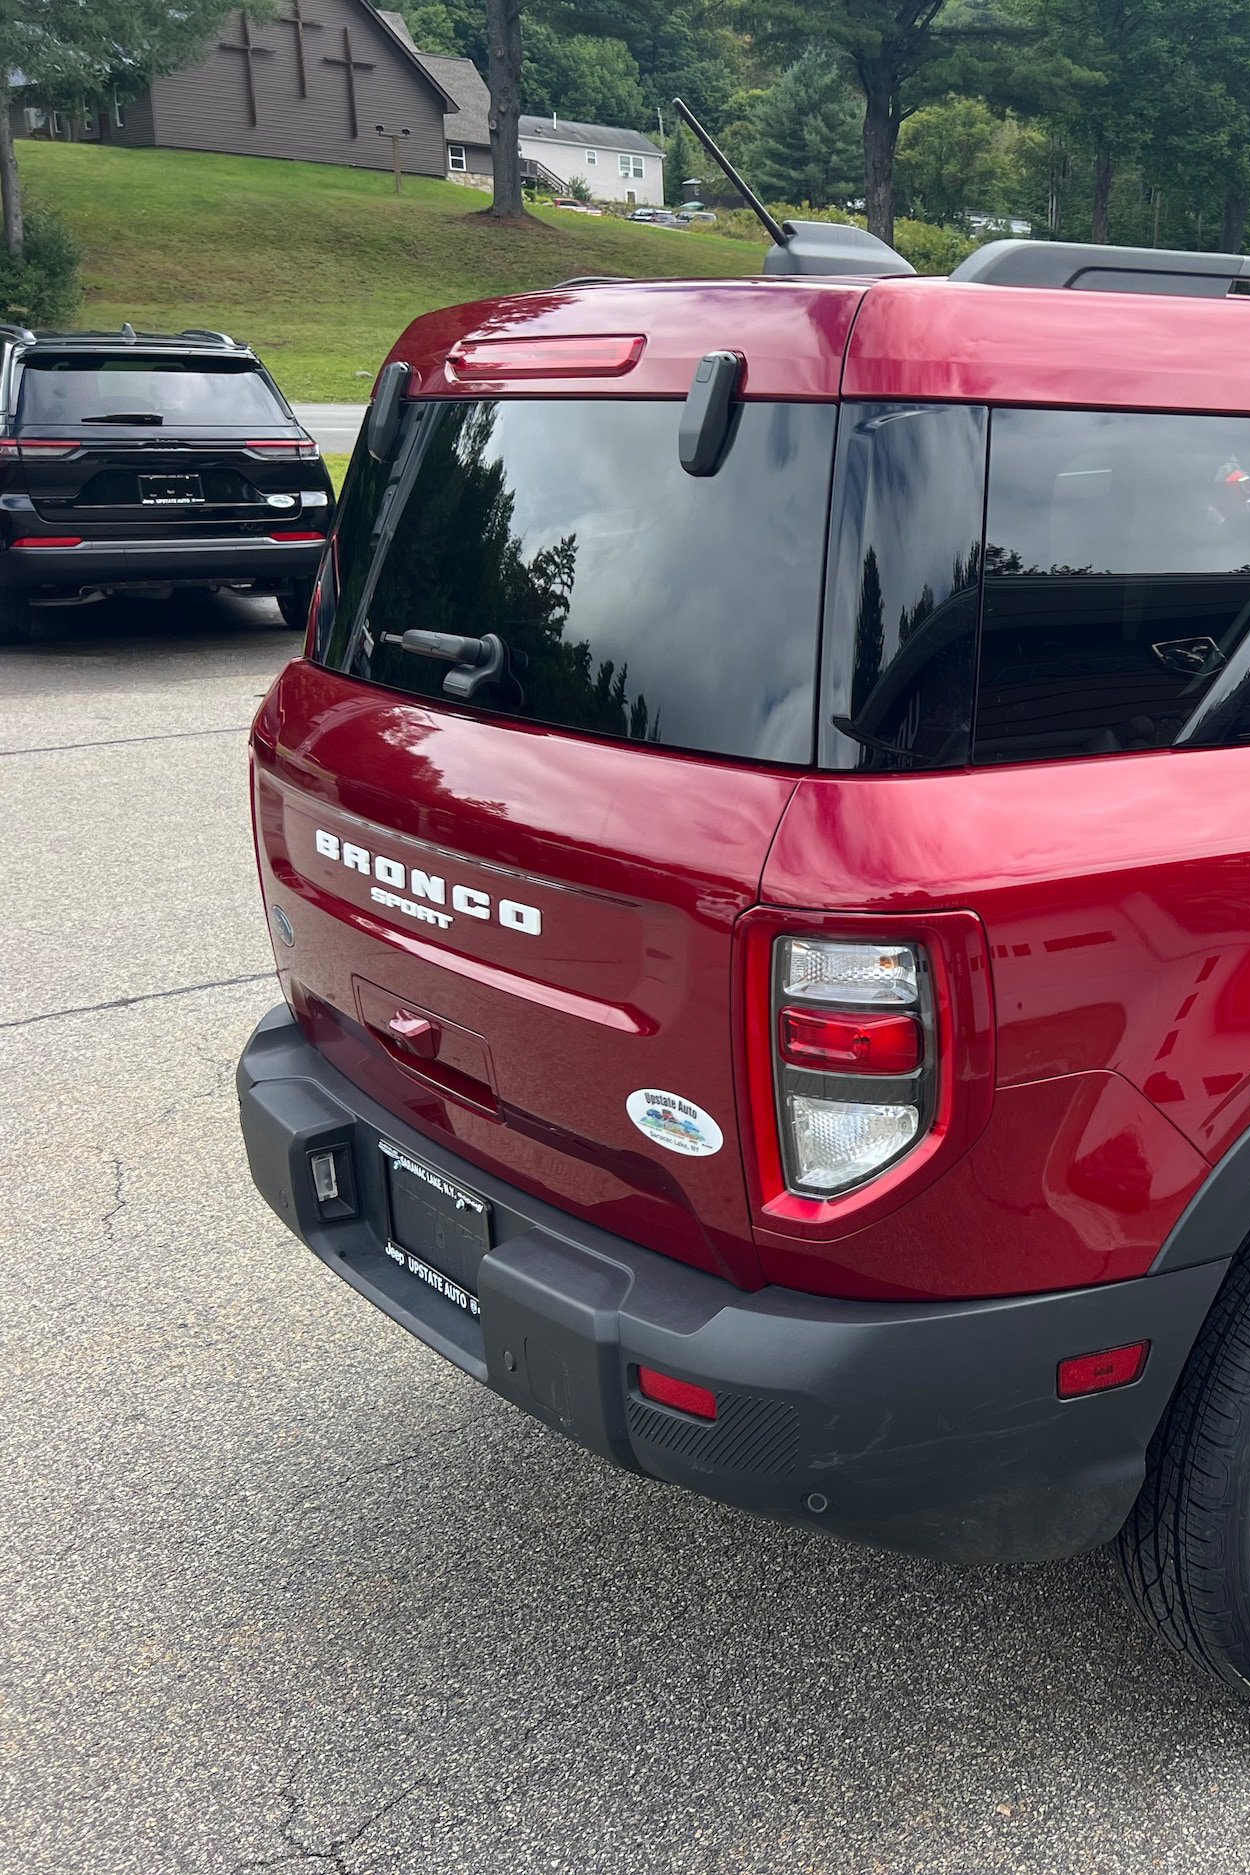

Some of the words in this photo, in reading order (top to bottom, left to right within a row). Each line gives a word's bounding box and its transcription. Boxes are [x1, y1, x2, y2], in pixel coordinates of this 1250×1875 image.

[315, 828, 543, 936] BRONCO
[370, 886, 455, 929] SPORT
[644, 1091, 677, 1110] Upstate
[678, 1100, 698, 1120] Auto
[399, 1155, 427, 1182] SARANAC
[385, 1241, 405, 1266] Jeep
[408, 1257, 443, 1292] UPSTATE
[444, 1283, 467, 1308] AUTO
